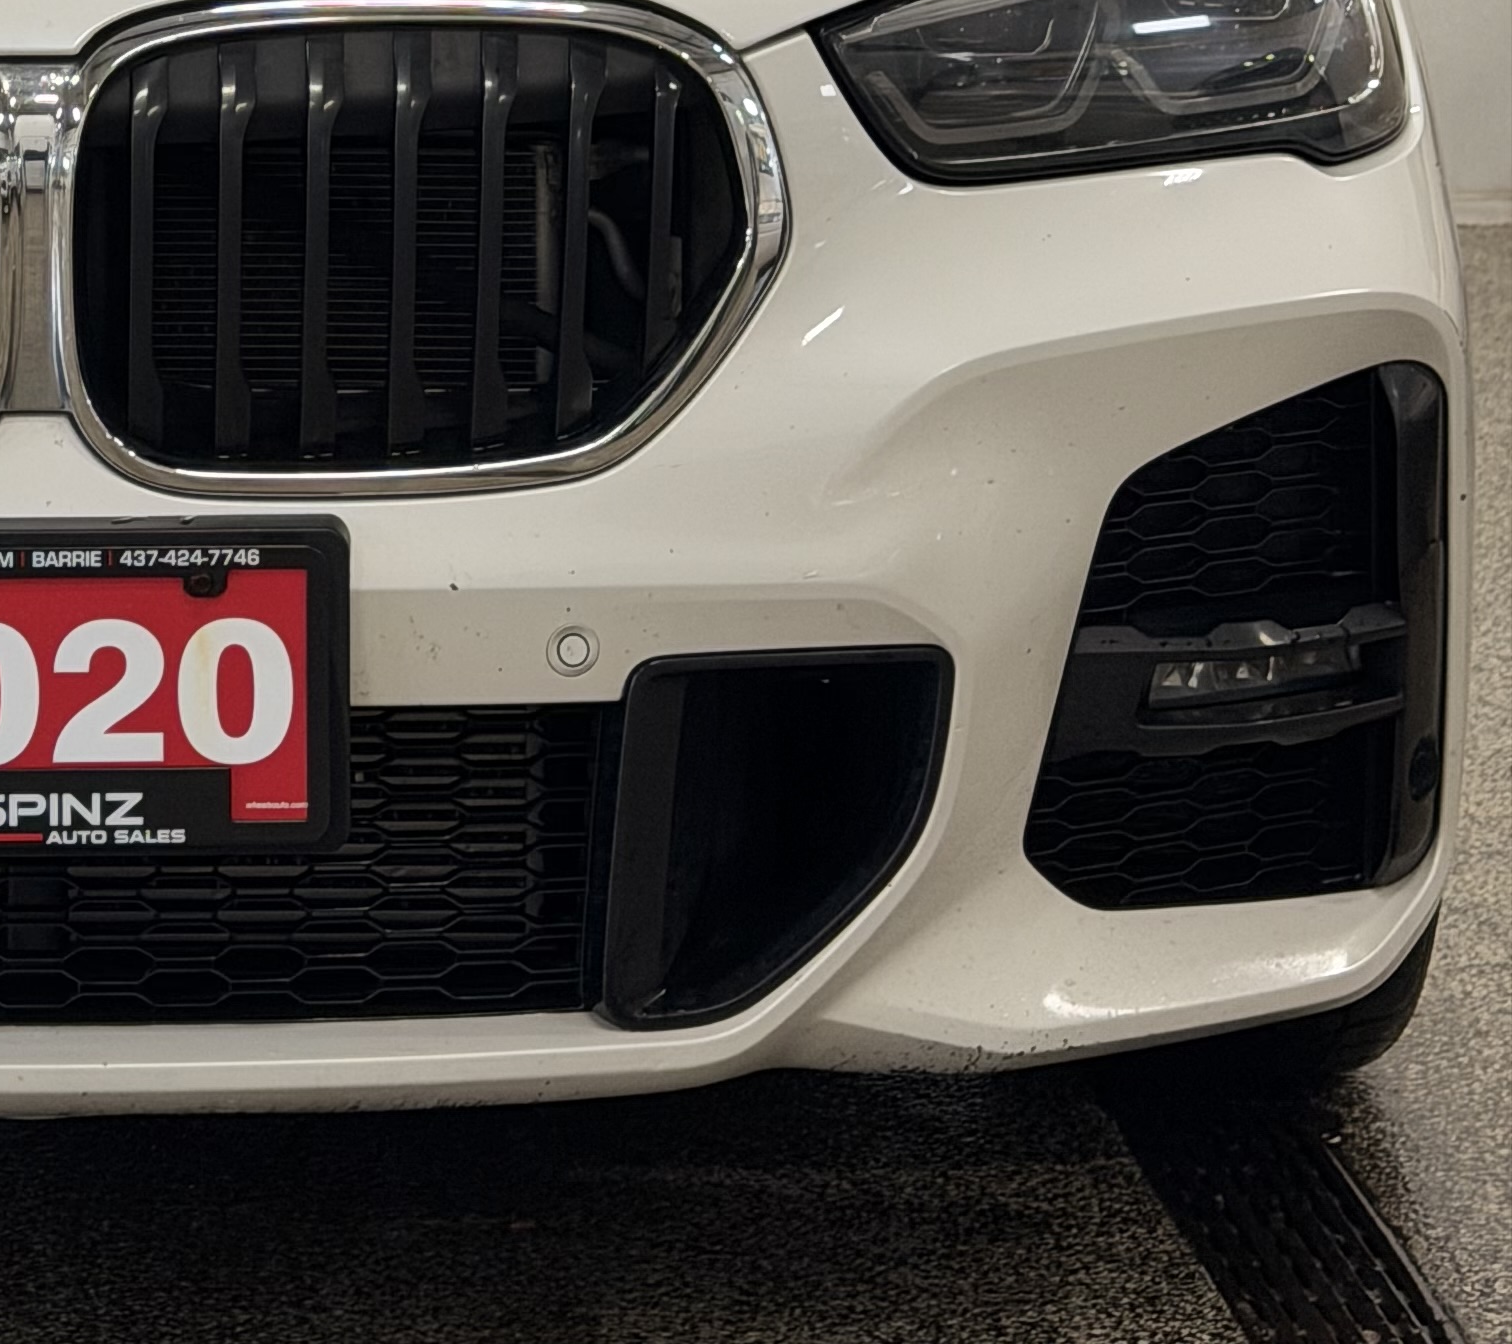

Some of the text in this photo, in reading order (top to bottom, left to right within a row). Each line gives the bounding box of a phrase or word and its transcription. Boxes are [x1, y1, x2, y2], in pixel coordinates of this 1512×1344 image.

[32, 550, 102, 568] BARRIE
[119, 548, 260, 567] 437-424-7746
[45, 828, 186, 845] AUTO SALES
